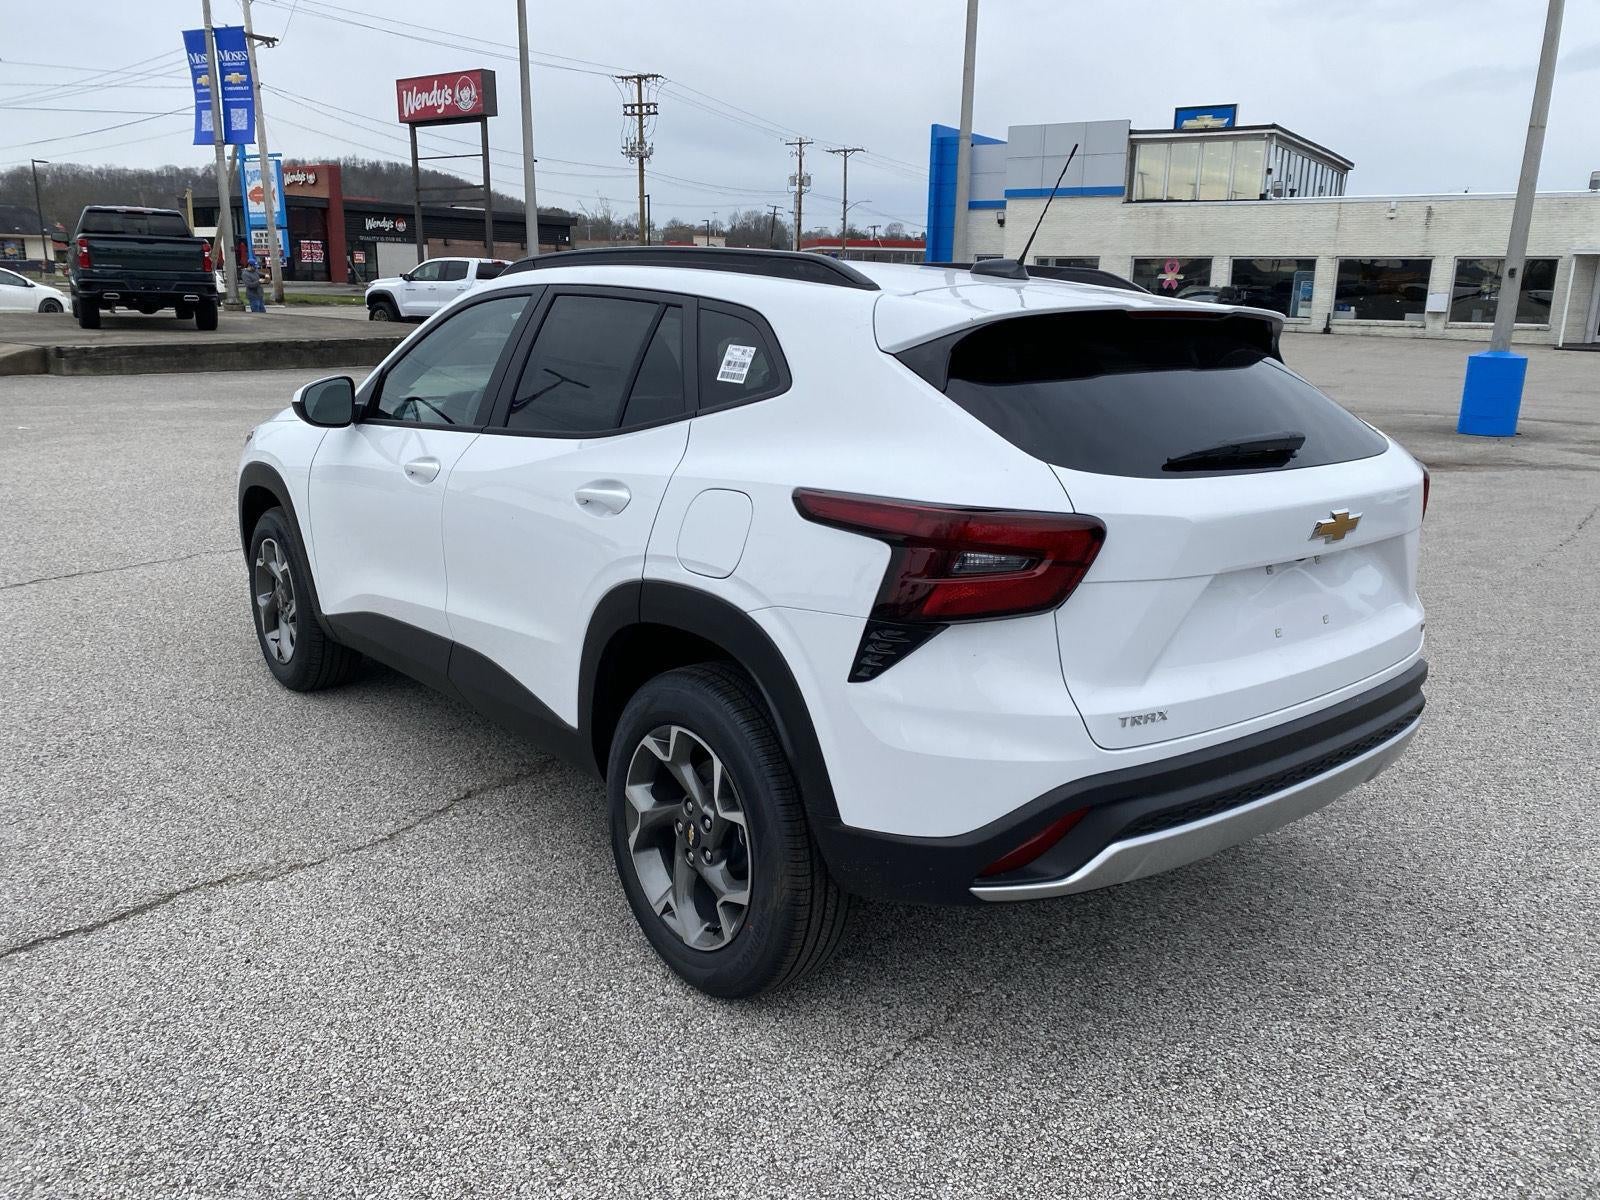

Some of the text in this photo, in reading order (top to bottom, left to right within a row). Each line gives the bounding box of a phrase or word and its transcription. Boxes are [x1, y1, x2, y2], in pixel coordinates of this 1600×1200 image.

[189, 52, 208, 64] MOS
[218, 50, 247, 61] MOSES
[402, 80, 452, 117] Wendy's
[283, 170, 306, 186] Wendy's
[365, 216, 394, 231] Wendy's
[1118, 711, 1168, 728] TRAX
